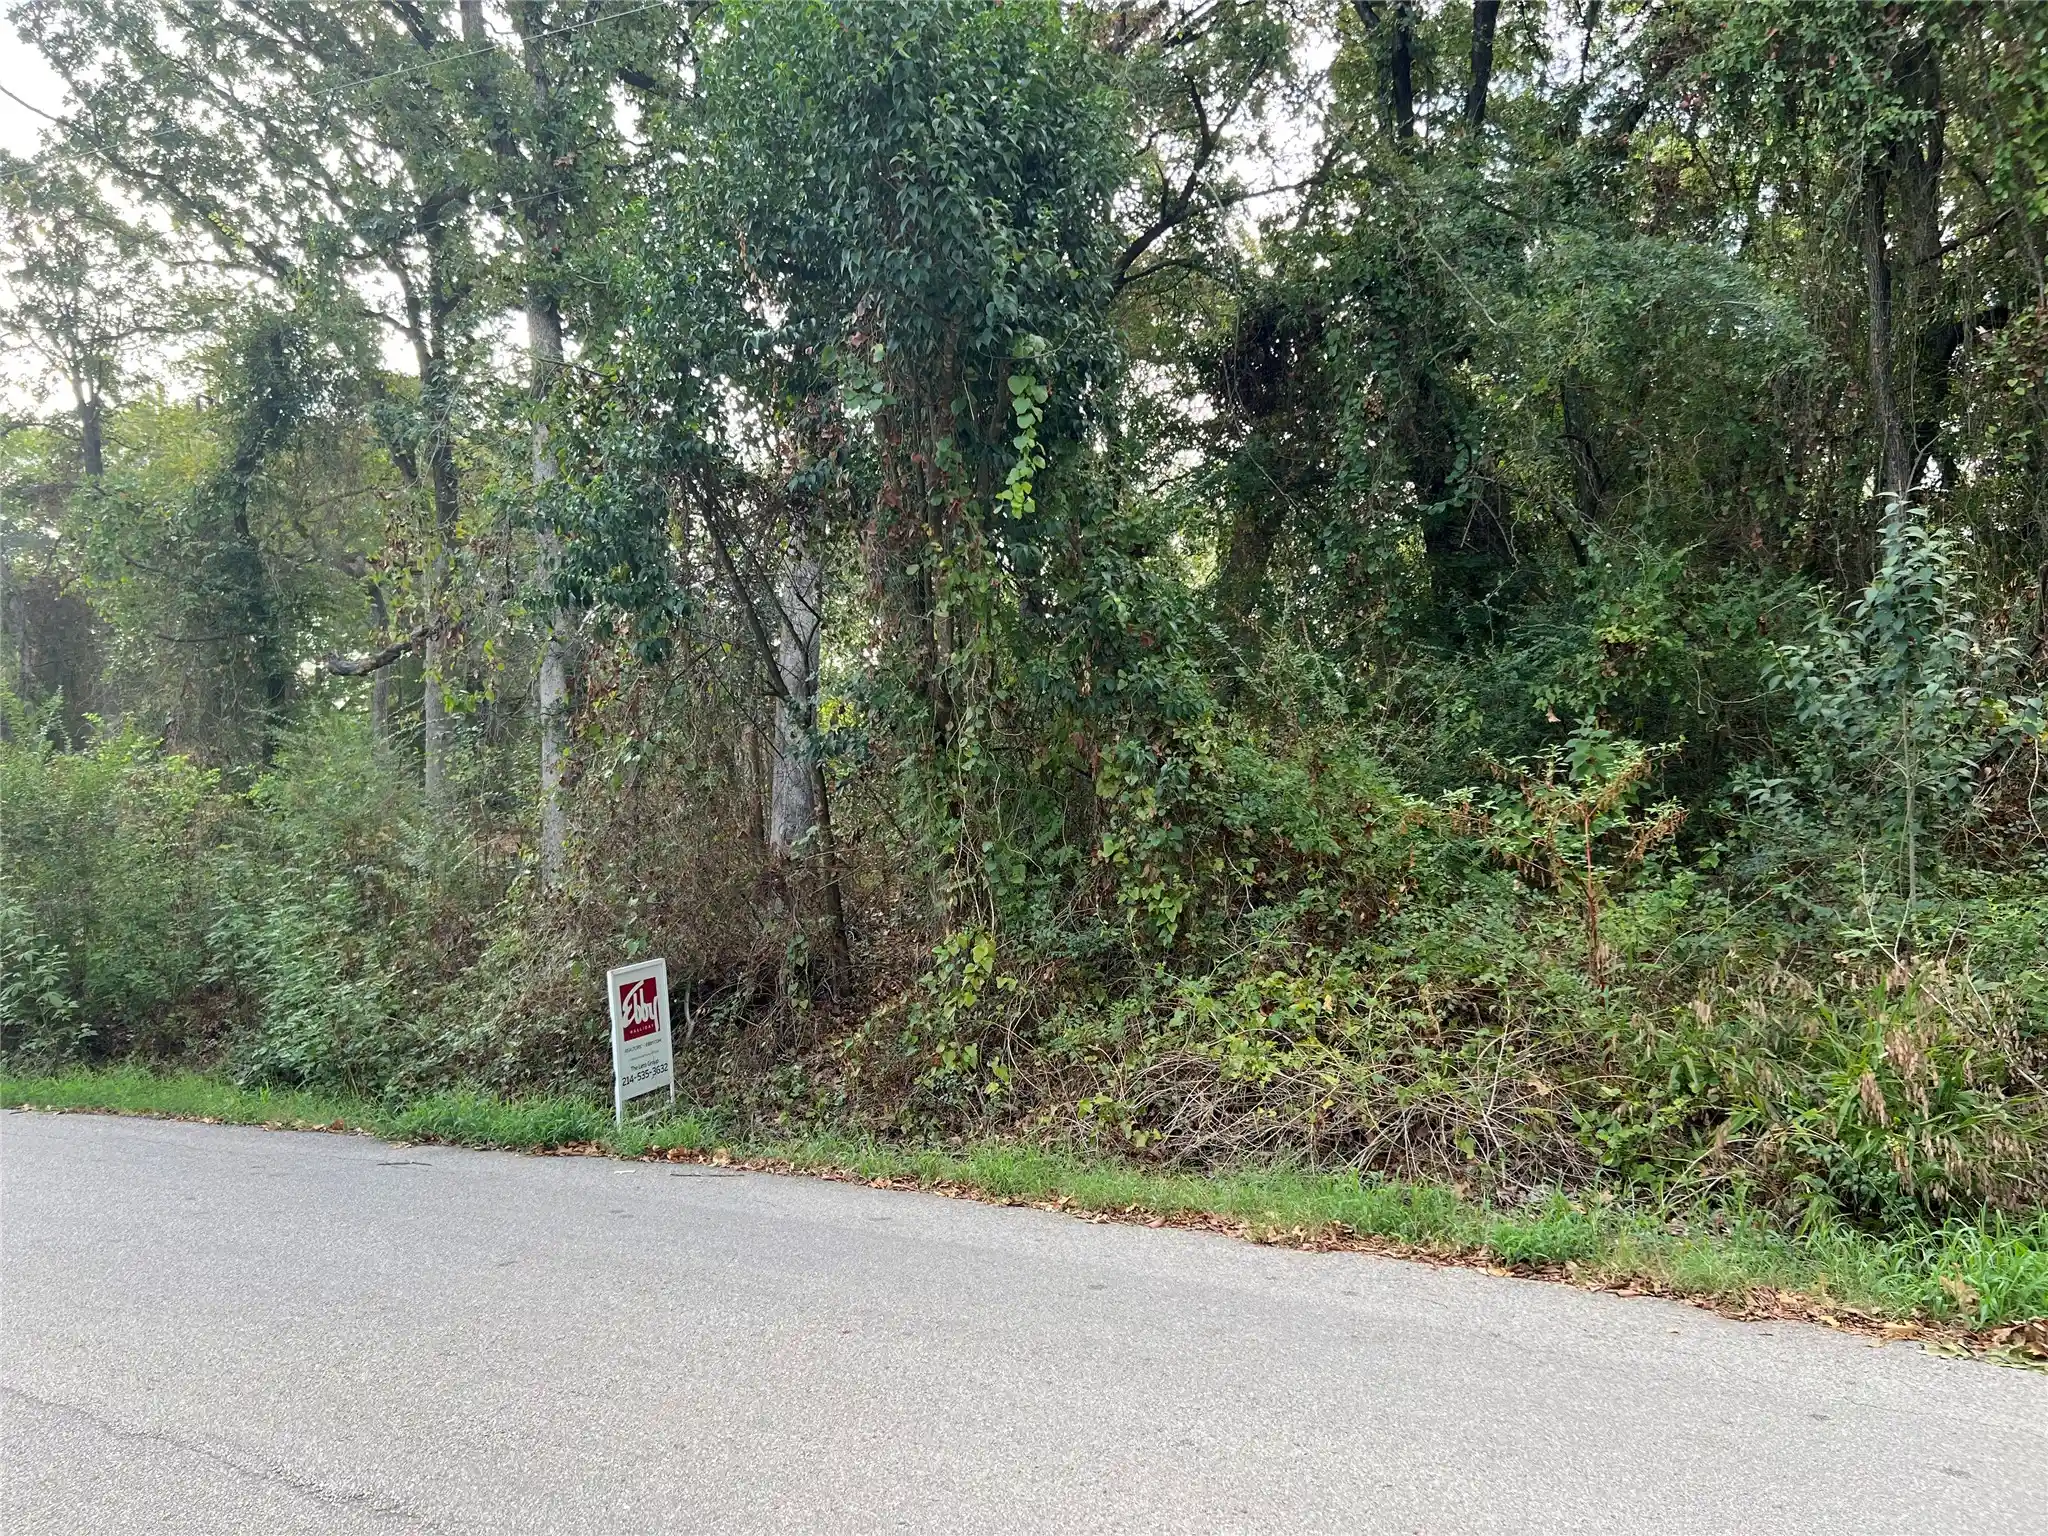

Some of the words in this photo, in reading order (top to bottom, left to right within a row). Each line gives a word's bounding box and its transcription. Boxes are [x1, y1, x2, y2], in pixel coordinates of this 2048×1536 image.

[622, 980, 660, 1033] Ebby
[629, 1023, 654, 1034] HALLIDAY
[622, 1063, 669, 1087] 214-535-3632
